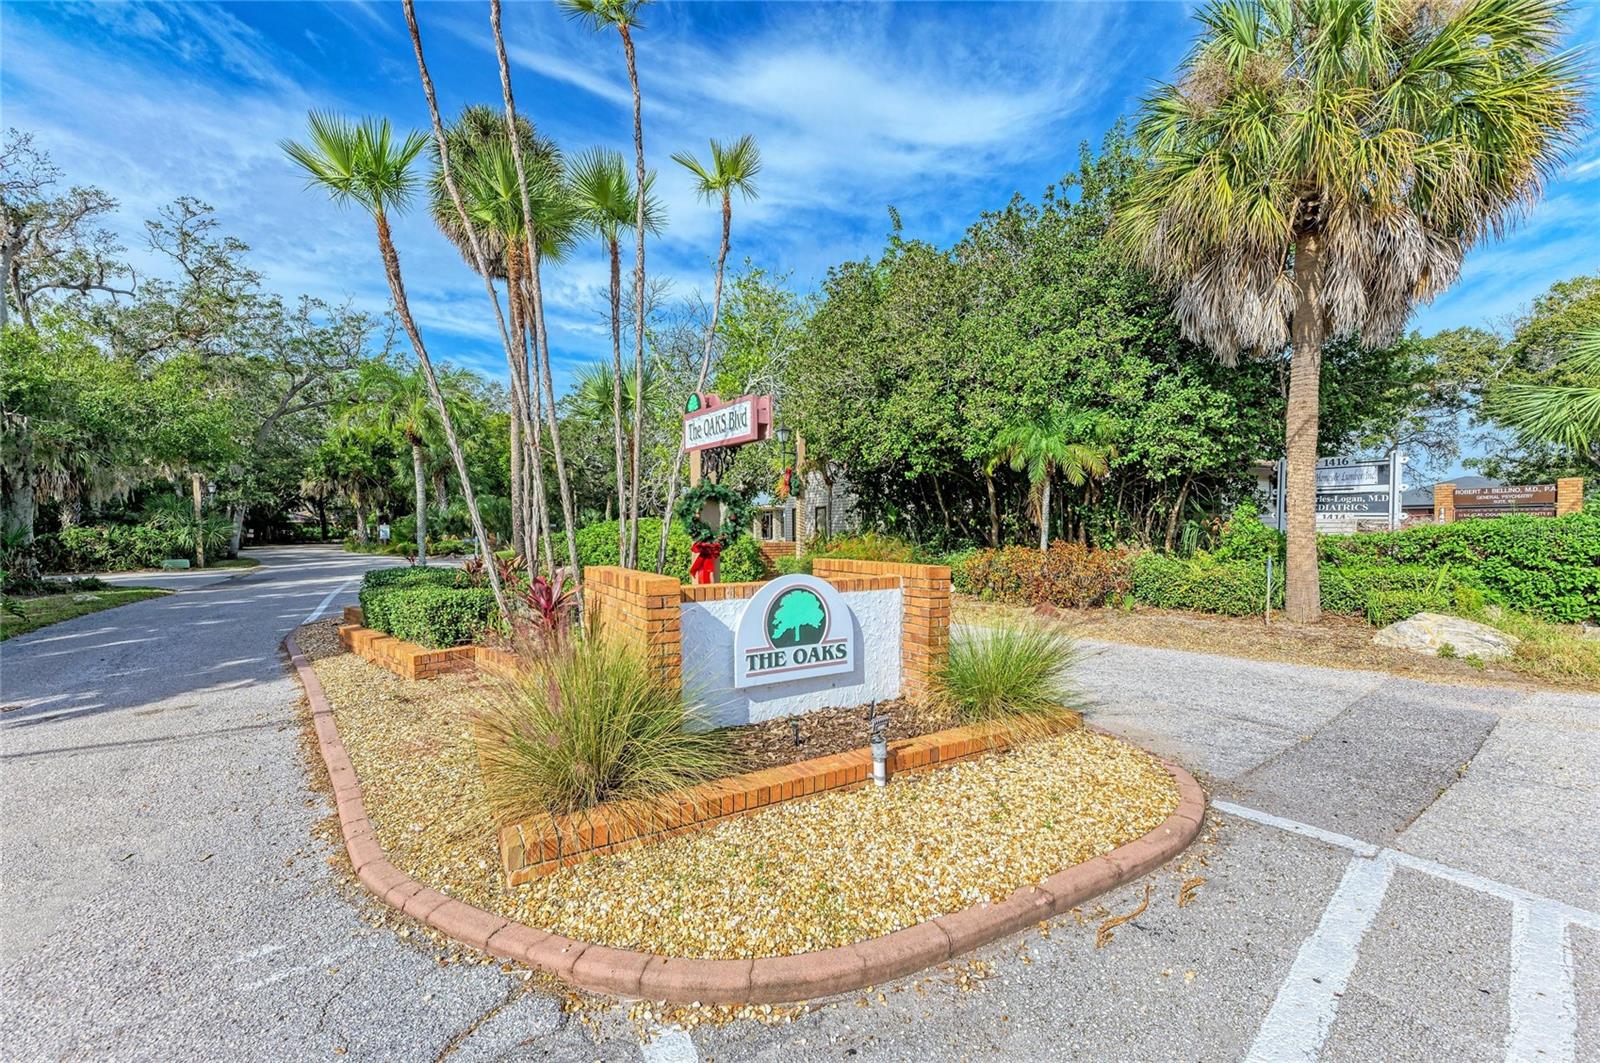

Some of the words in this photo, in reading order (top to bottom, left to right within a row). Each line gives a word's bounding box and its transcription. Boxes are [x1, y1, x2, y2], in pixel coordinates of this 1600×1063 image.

[689, 423, 701, 441] The
[704, 413, 727, 437] OAKS
[729, 407, 747, 431] Blvd
[1325, 457, 1349, 467] 1416
[1315, 494, 1366, 504] rles-Logan,
[1317, 503, 1369, 511] DIATRICS
[746, 652, 786, 671] THE
[793, 644, 847, 664] OAKS
